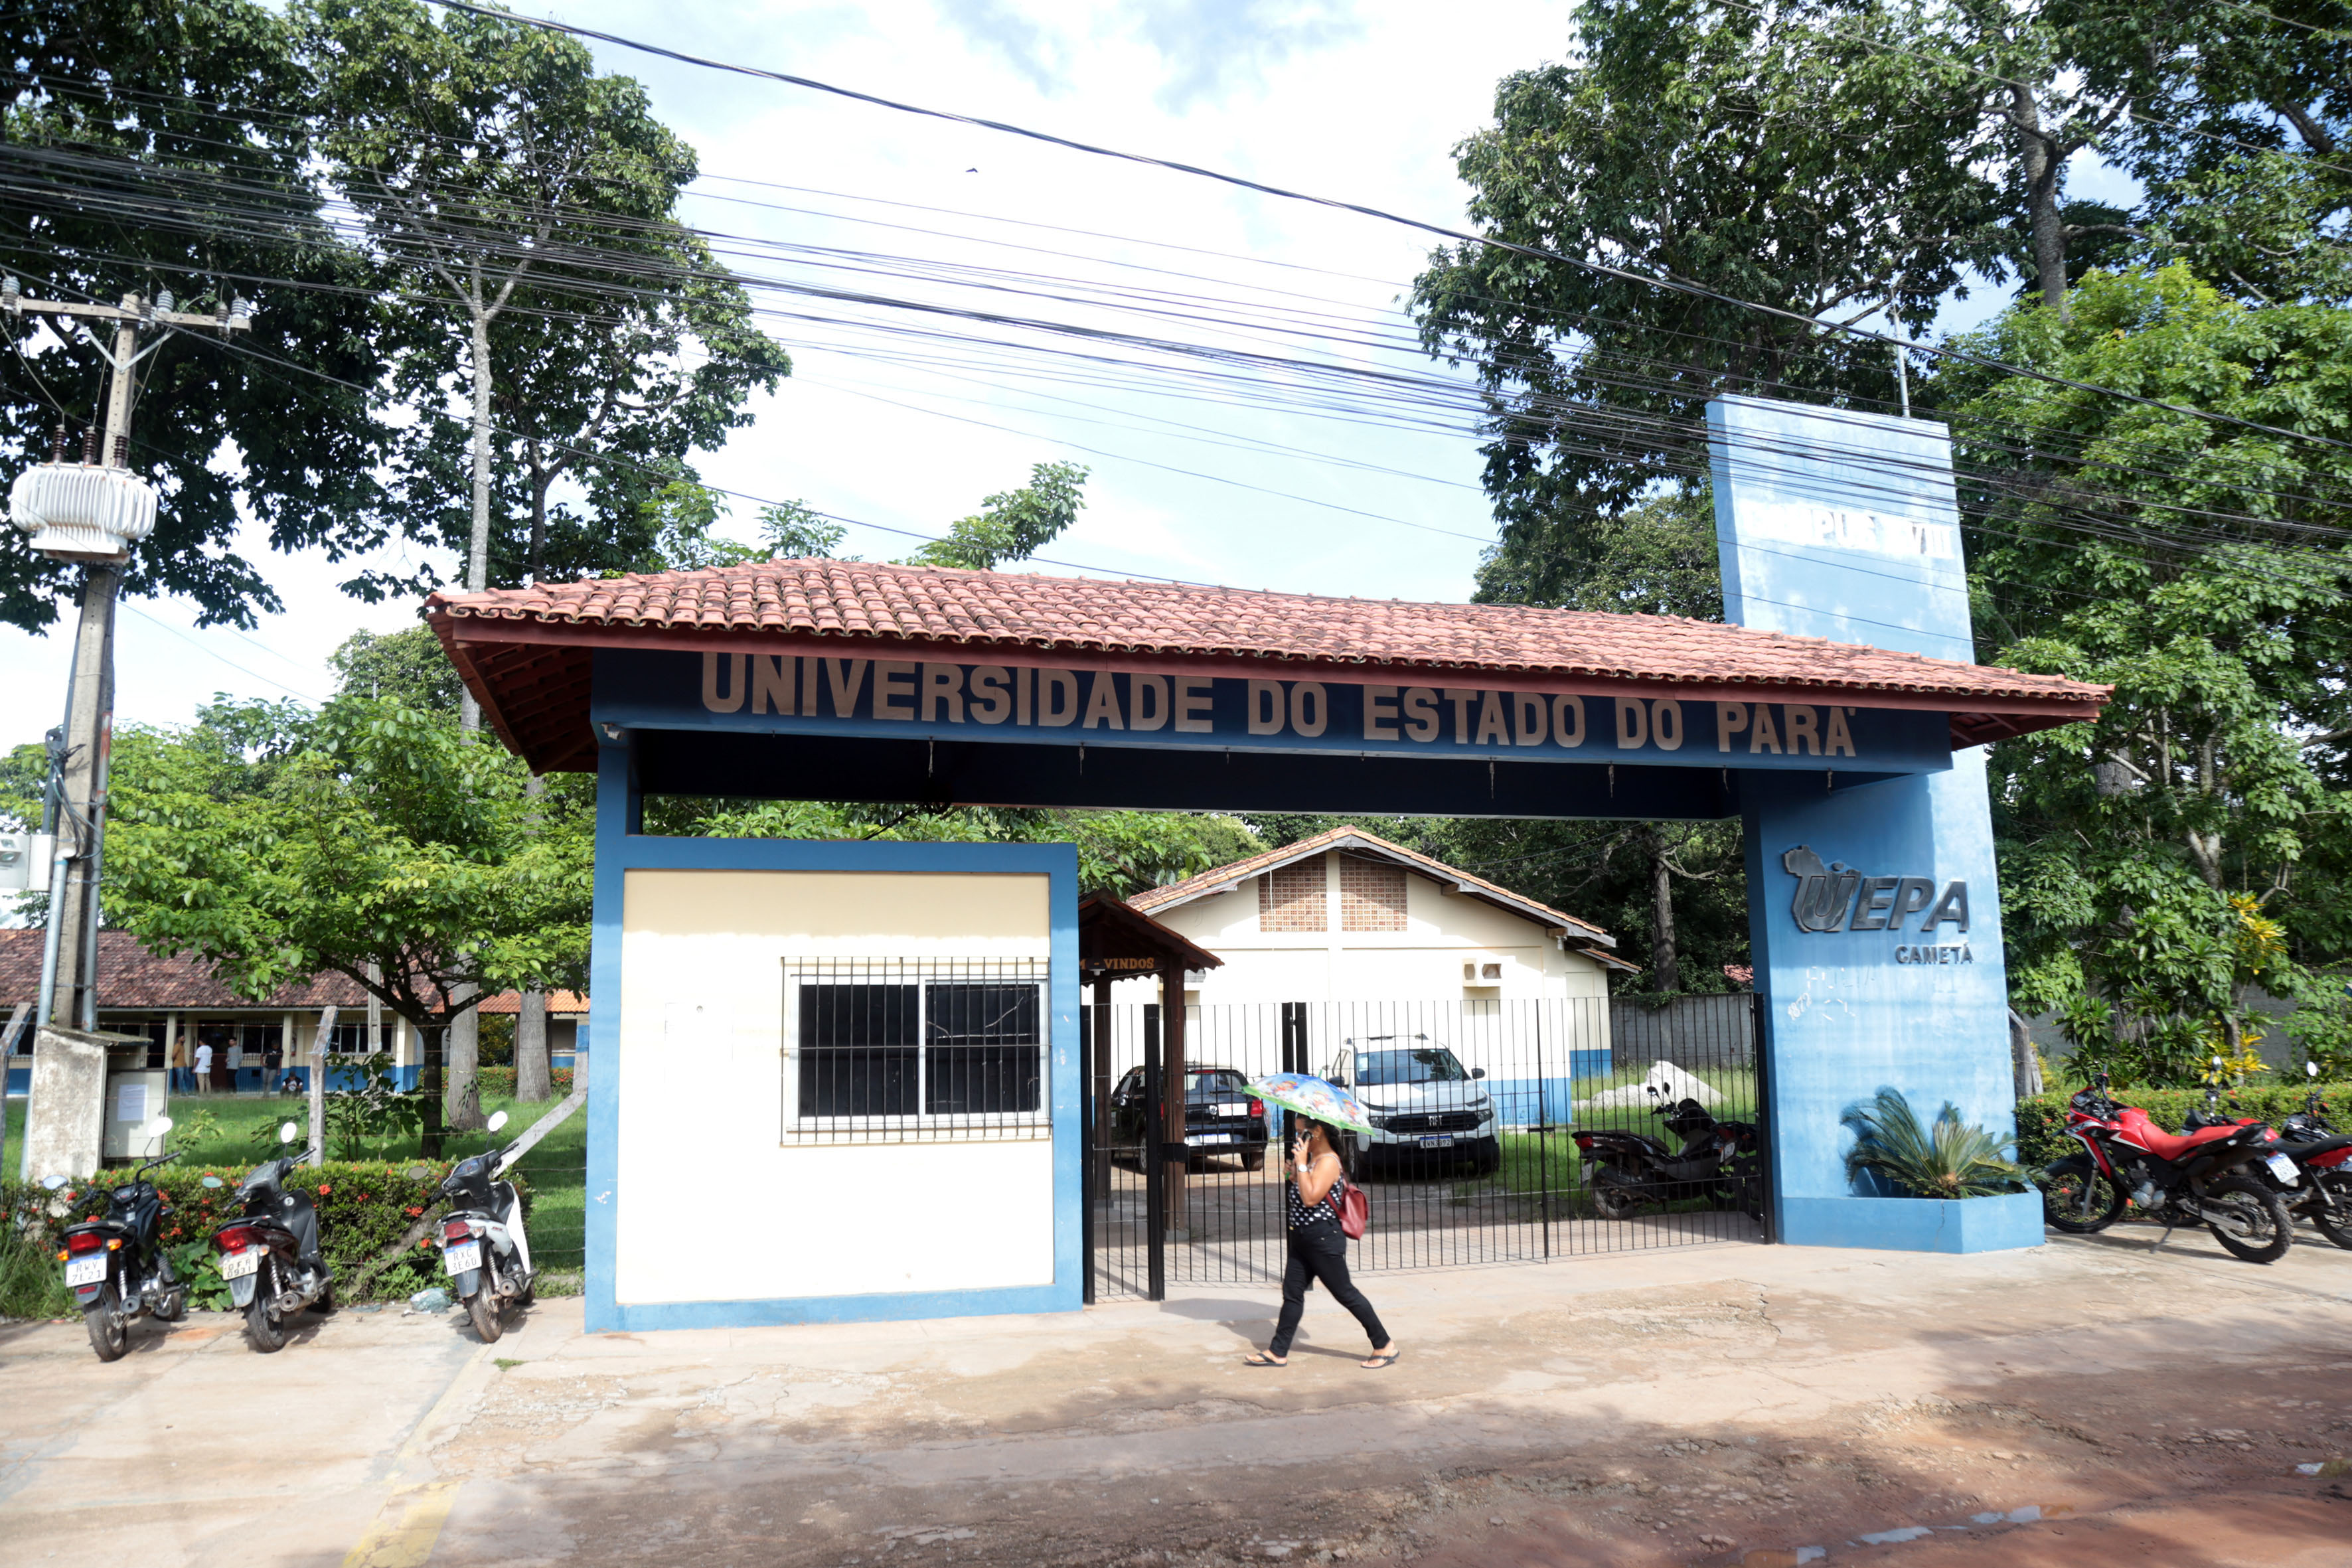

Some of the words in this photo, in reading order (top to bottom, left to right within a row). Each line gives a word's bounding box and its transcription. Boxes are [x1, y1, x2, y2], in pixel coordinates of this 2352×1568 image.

[702, 651, 1214, 733] UNIVERSIDADE
[1247, 679, 1327, 737] DO
[1363, 684, 1586, 748] ESTADO
[1615, 697, 1684, 751] DO
[1717, 701, 1857, 757] PARÁ
[1799, 876, 1970, 933] UEPA
[1895, 942, 1974, 964] CAMETÁ
[1103, 957, 1155, 970] VINDOS
[1428, 1115, 1443, 1127] FIAT
[453, 1248, 472, 1262] RXC
